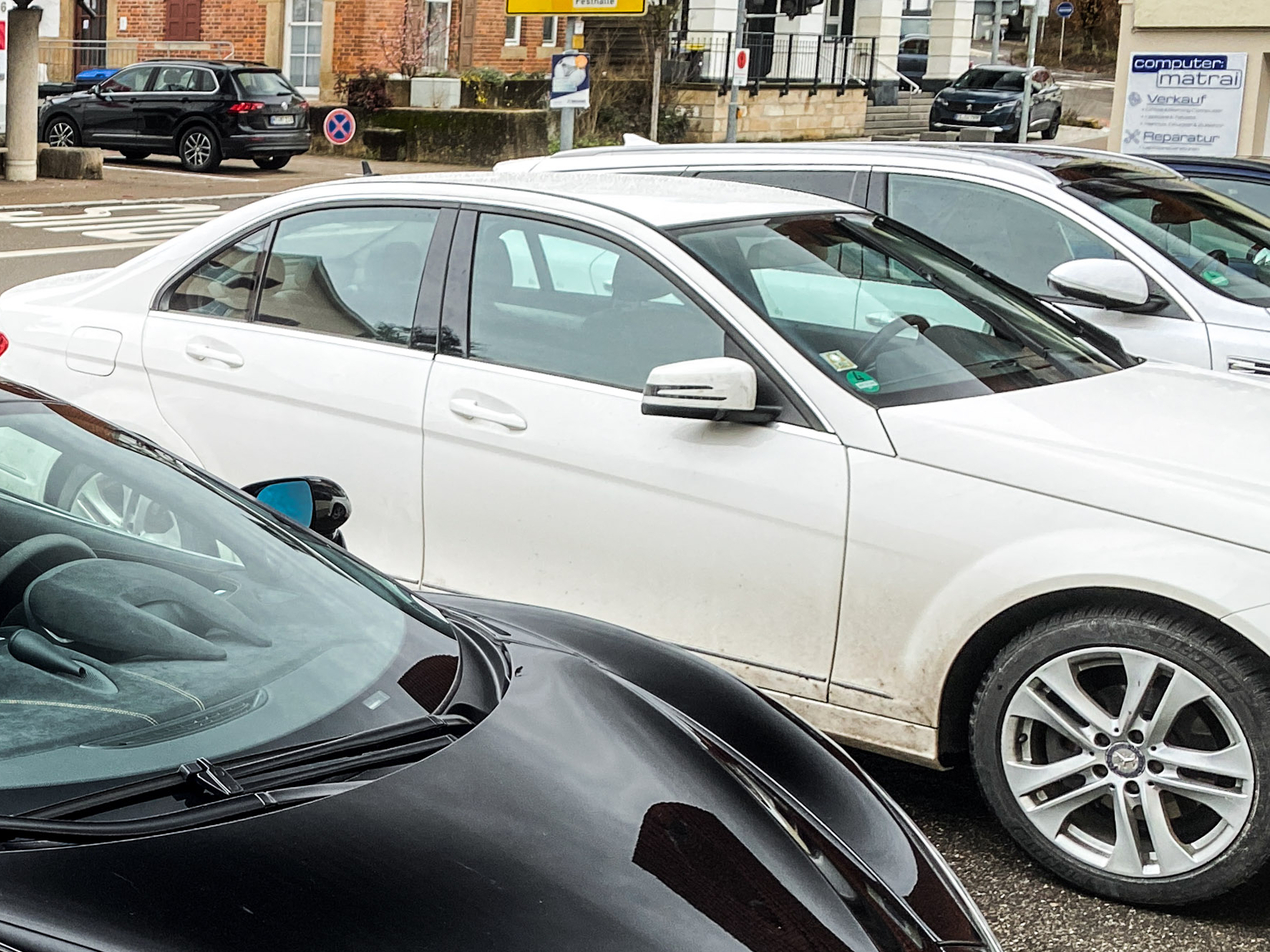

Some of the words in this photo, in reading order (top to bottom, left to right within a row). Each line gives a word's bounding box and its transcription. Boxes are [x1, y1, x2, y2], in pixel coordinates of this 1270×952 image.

[0, 1, 7, 12] 6
[1146, 94, 1207, 104] Verkauf
[1143, 131, 1220, 143] Reparatur
